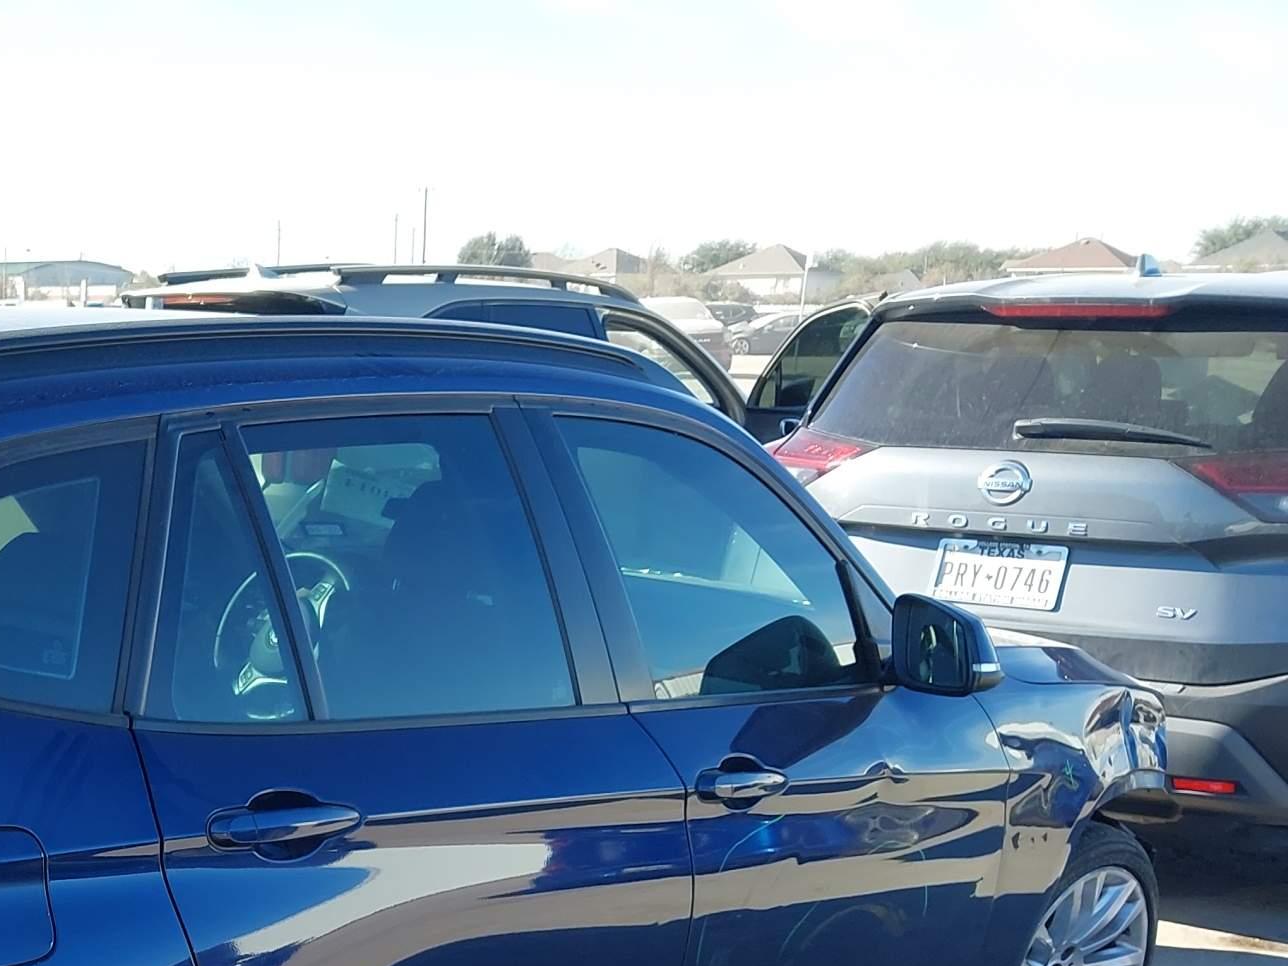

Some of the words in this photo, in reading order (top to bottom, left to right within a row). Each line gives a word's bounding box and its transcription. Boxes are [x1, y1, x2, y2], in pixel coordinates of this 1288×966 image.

[984, 480, 1024, 489] NISSAN
[911, 511, 1089, 537] ROGUE
[978, 544, 1025, 559] TEXAS
[1155, 605, 1199, 620] SV
